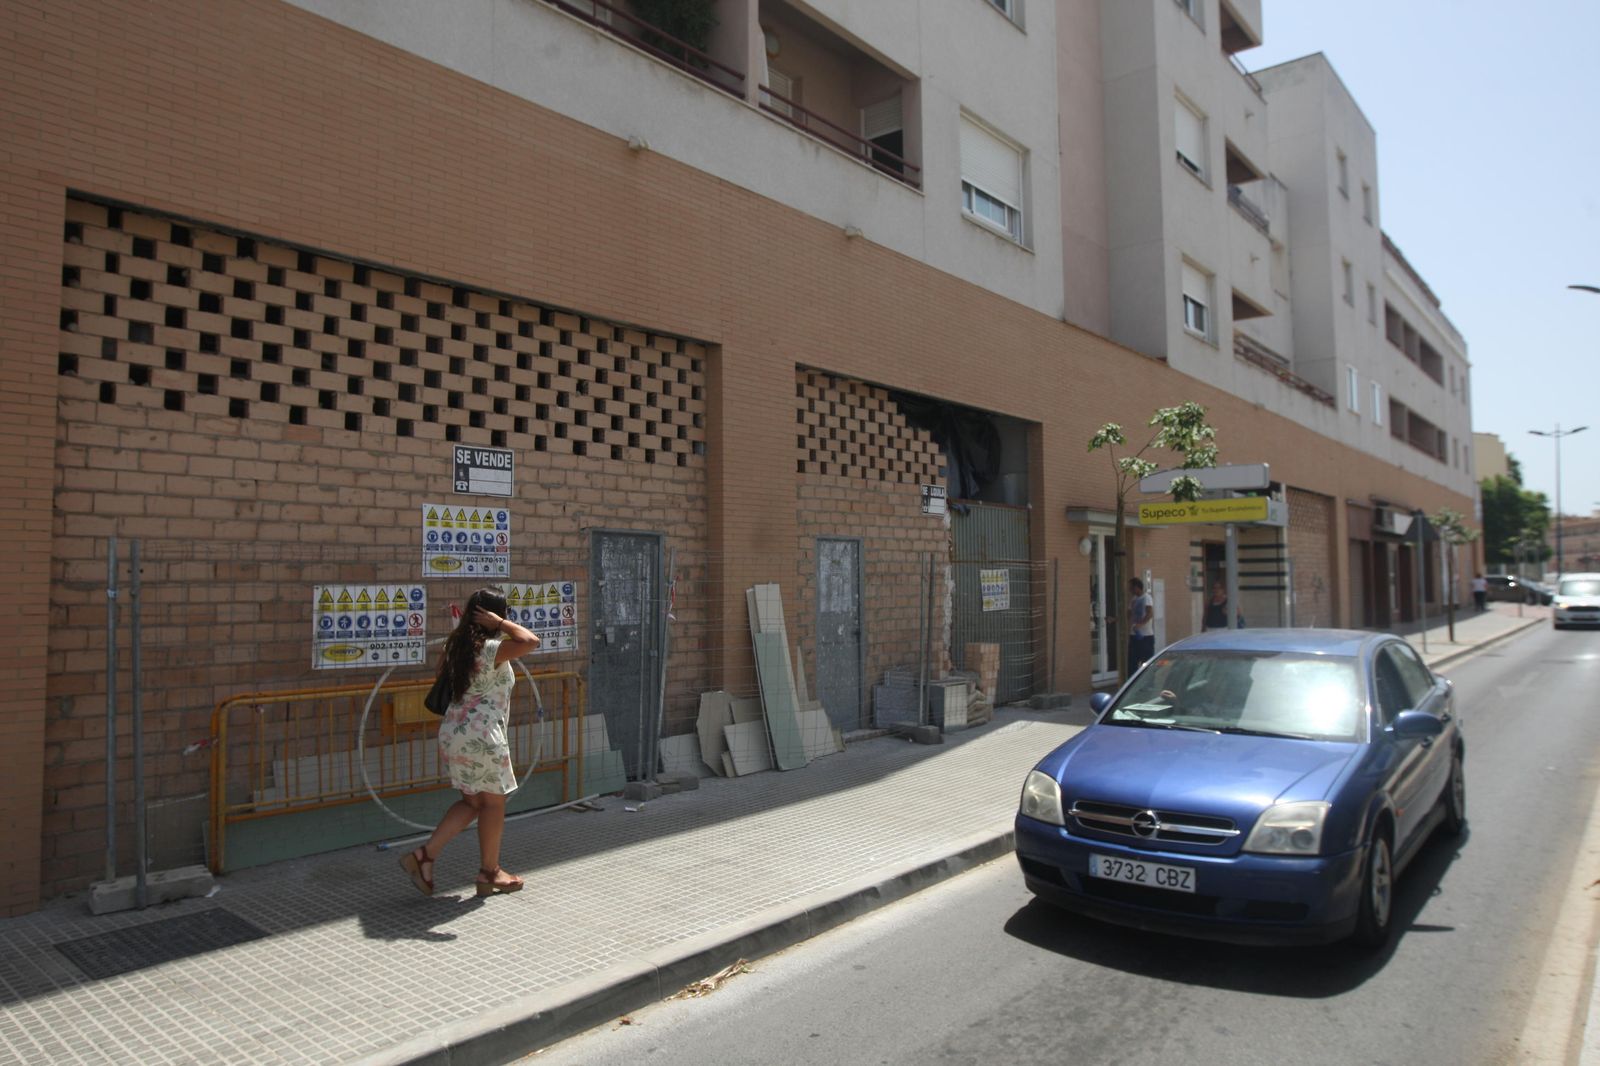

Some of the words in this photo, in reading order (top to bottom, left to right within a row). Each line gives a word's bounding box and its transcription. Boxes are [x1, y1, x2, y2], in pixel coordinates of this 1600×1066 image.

[456, 449, 471, 465] SE
[474, 451, 511, 468] VENDE
[1141, 508, 1186, 520] Supeco
[1103, 859, 1146, 883] 3732
[1155, 867, 1191, 890] CBZ
